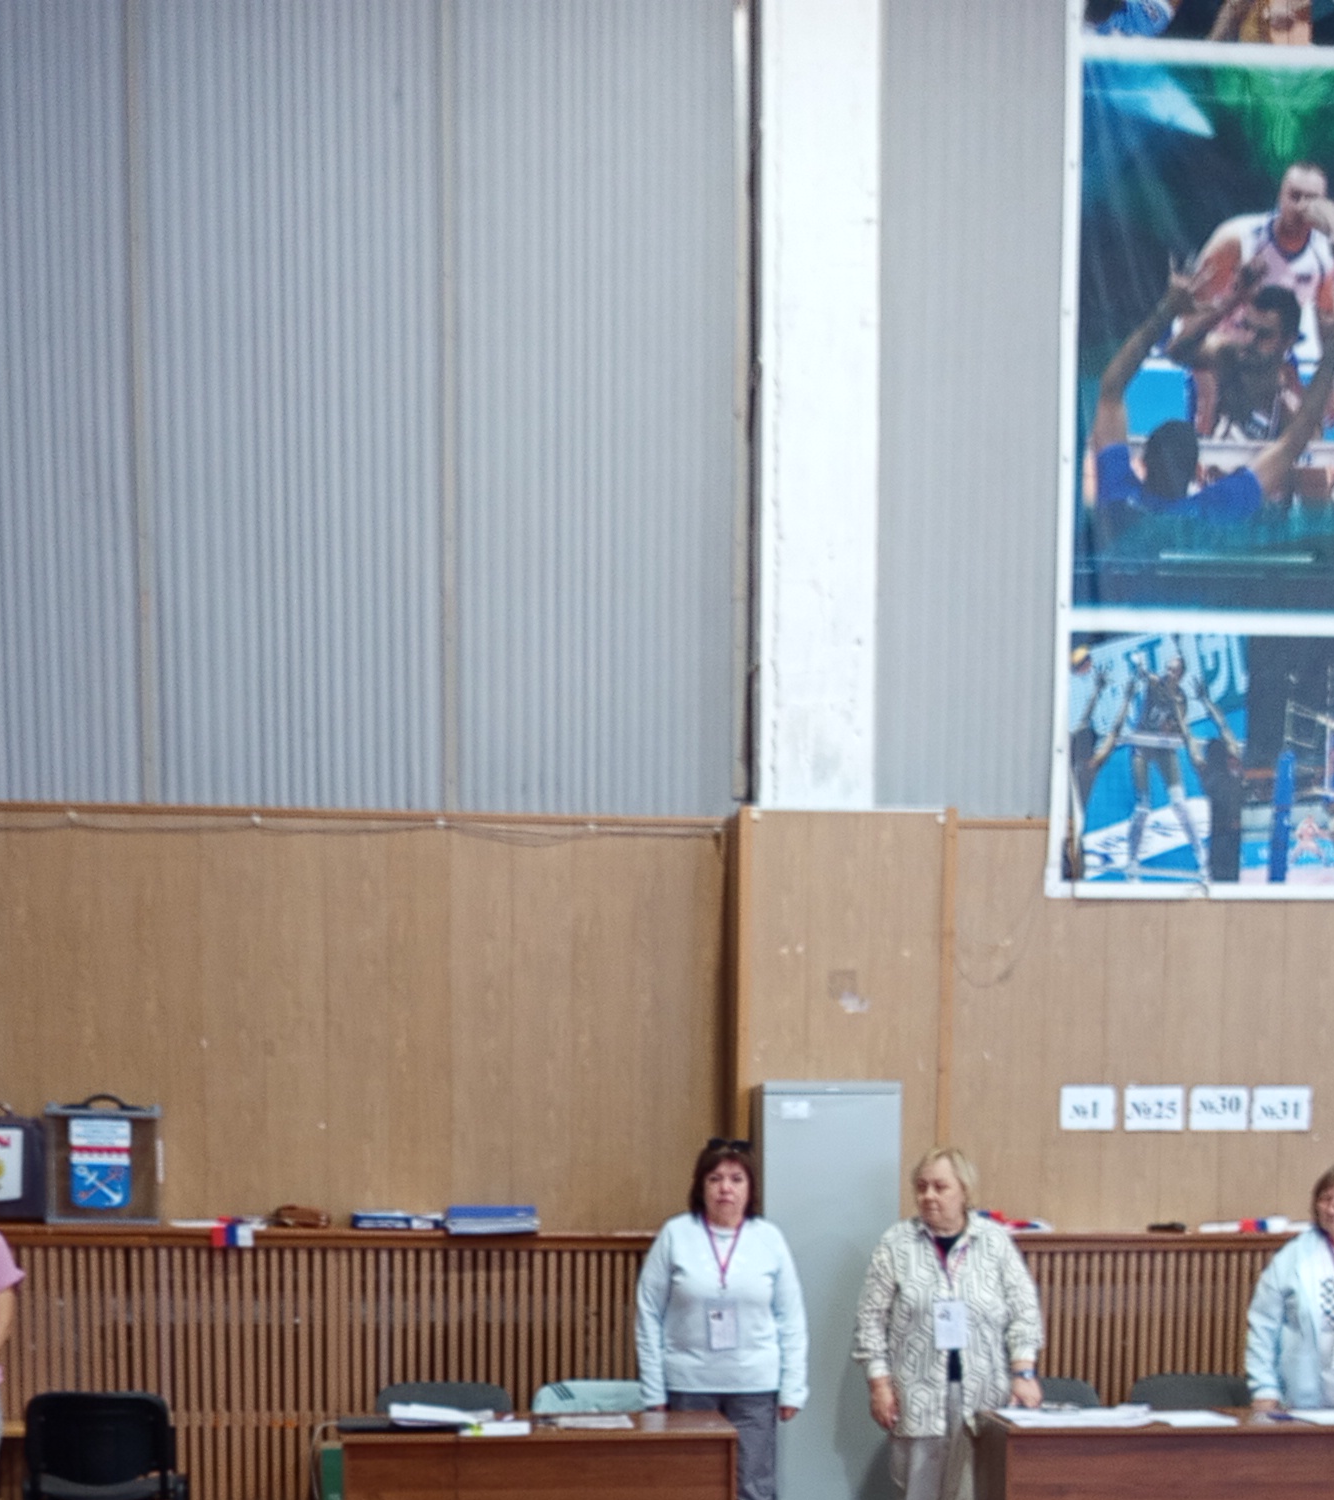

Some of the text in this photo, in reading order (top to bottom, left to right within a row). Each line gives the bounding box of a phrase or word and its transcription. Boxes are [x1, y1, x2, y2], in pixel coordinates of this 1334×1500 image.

[1069, 1101, 1099, 1119] №1
[1126, 1101, 1178, 1120] №25
[1197, 1095, 1242, 1115] №30
[1259, 1101, 1301, 1120] №31
